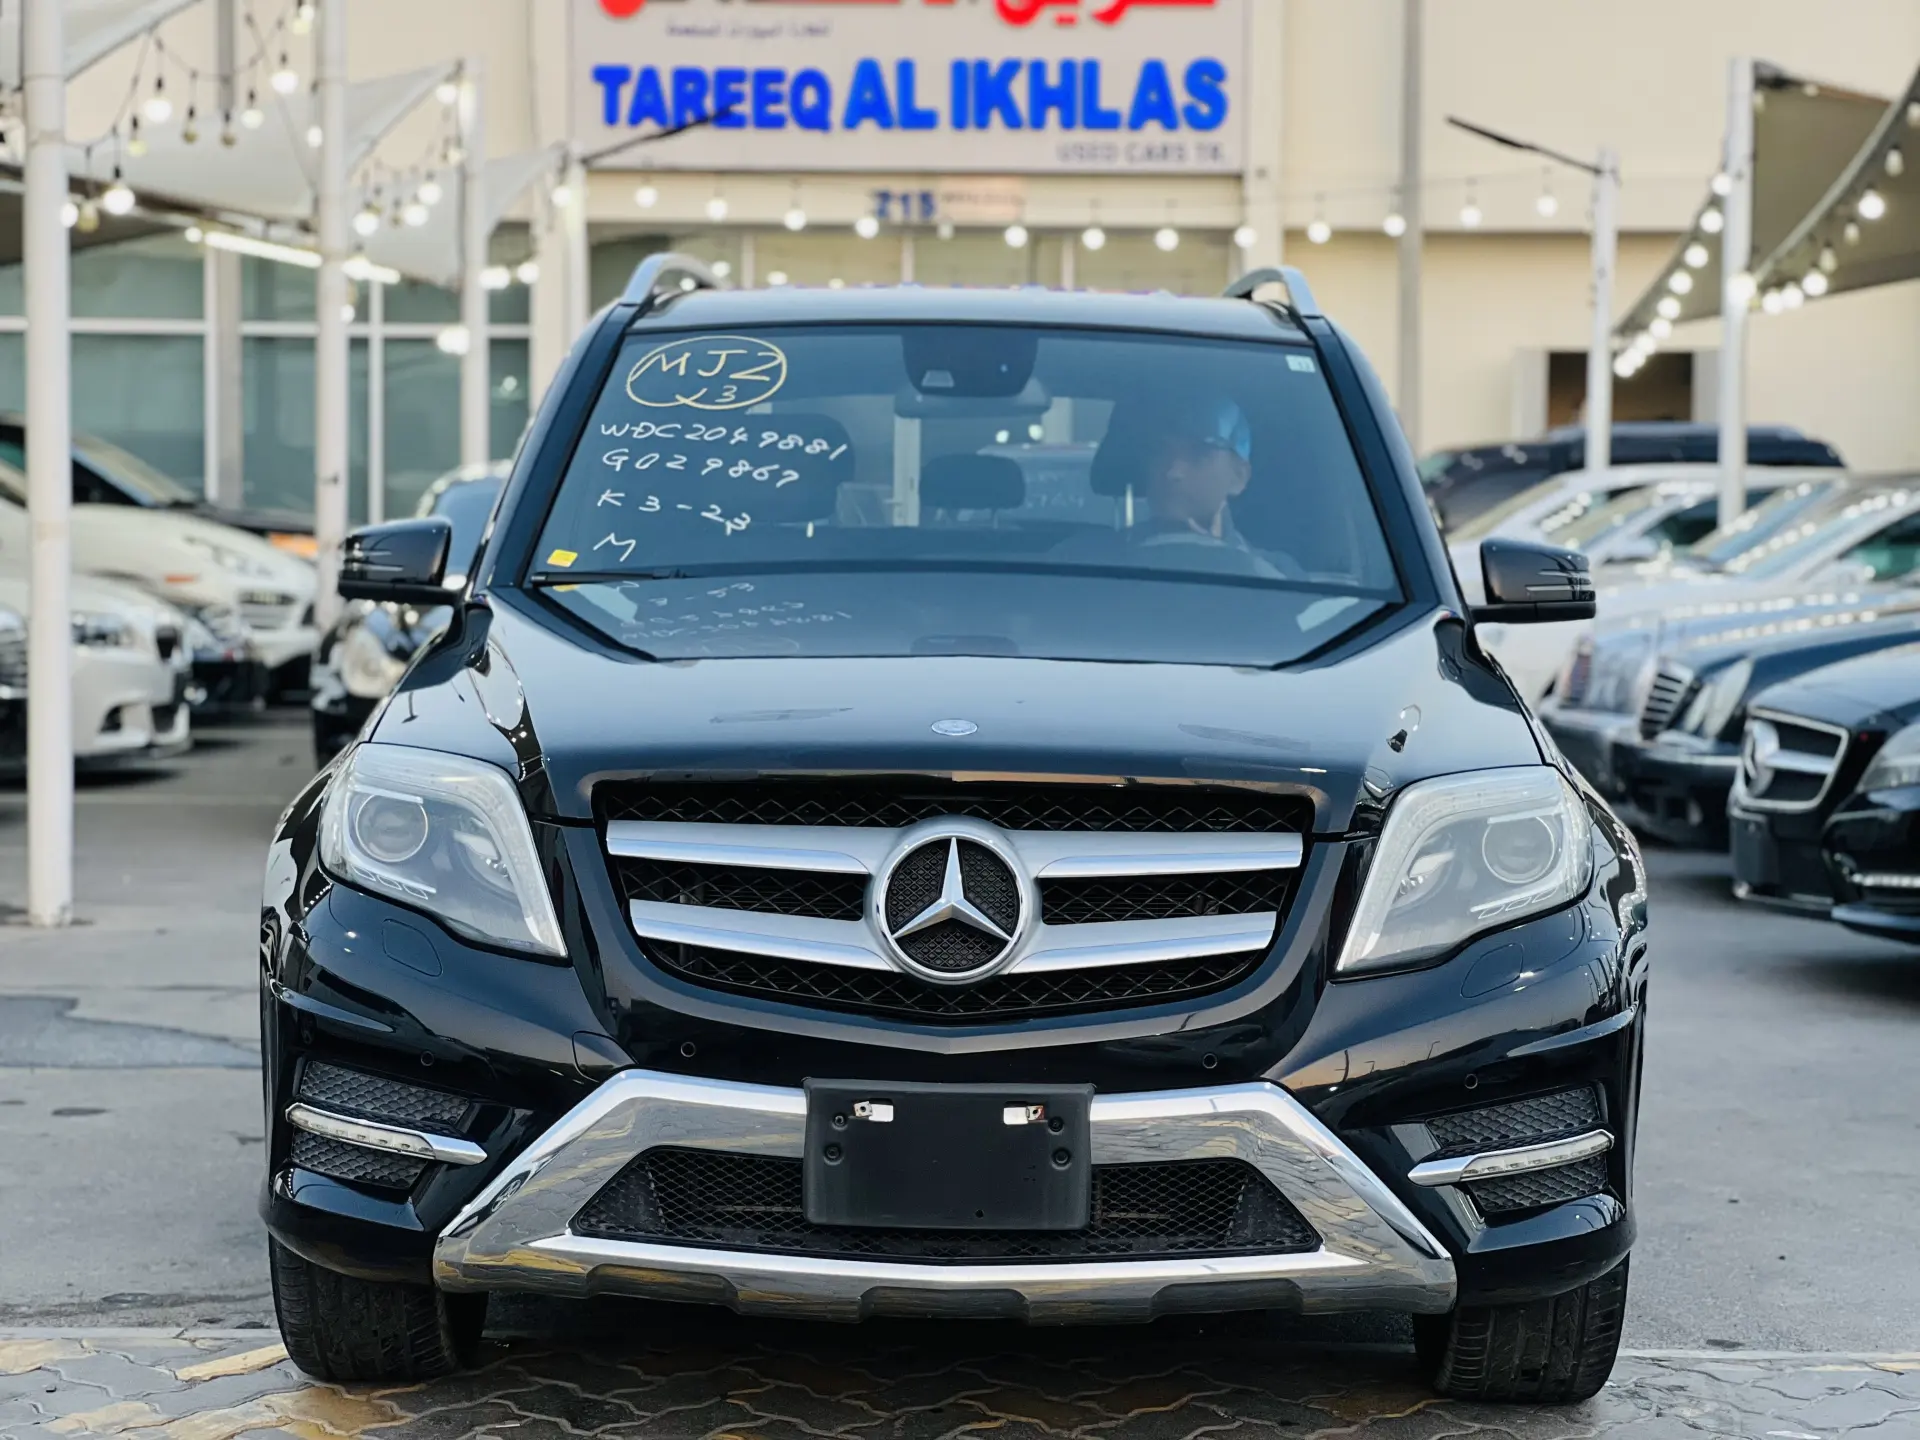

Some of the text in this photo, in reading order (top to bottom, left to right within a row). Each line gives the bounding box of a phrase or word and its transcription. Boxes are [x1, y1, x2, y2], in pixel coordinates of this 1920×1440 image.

[592, 57, 1229, 133] TAREEQ AL IKHLAS
